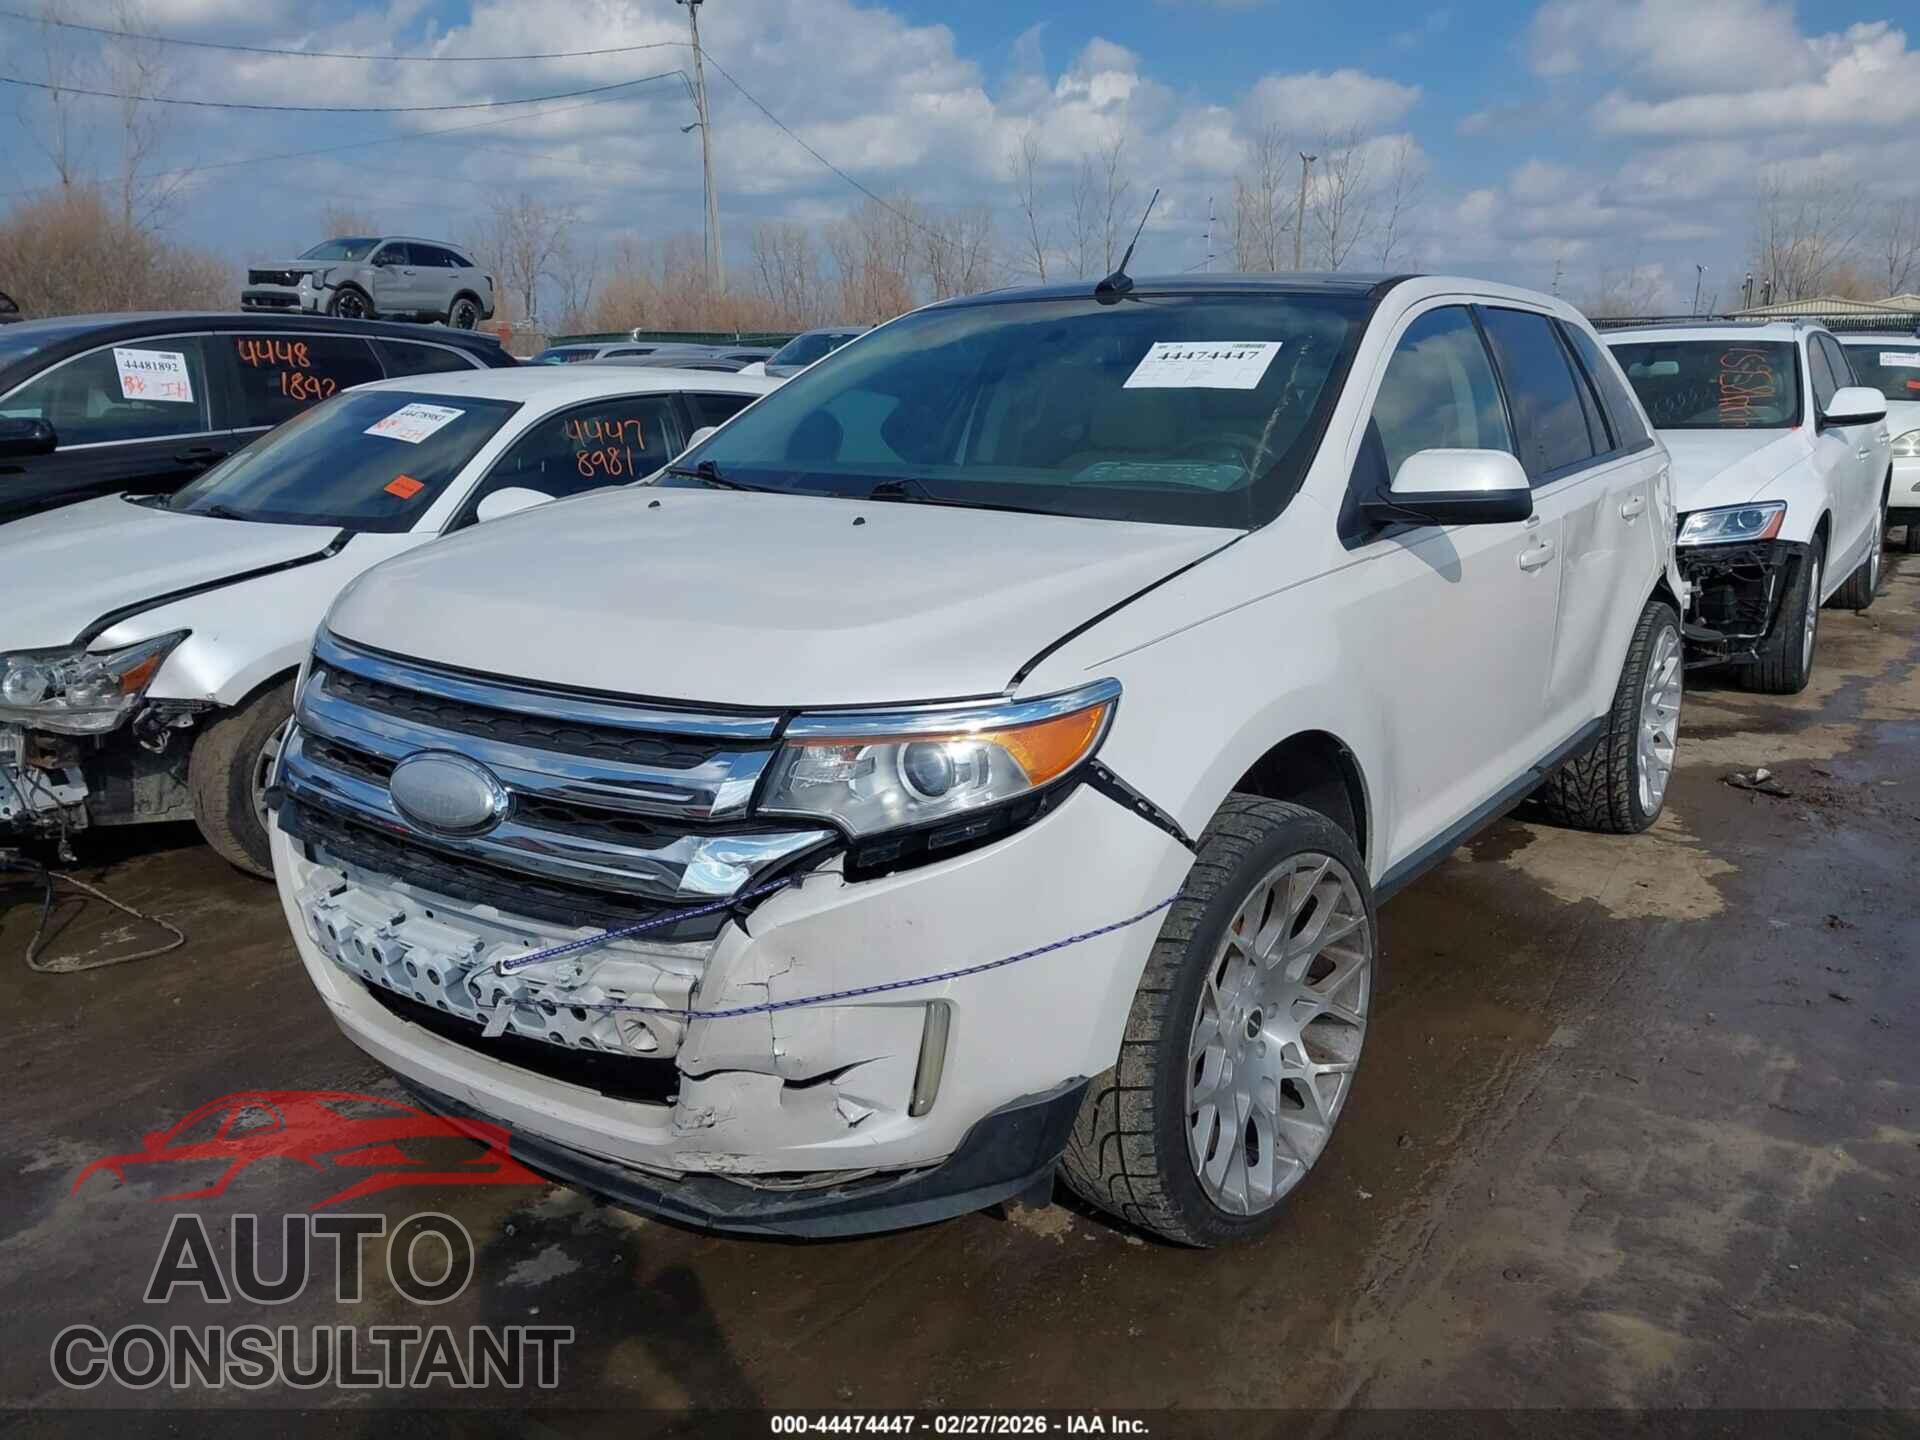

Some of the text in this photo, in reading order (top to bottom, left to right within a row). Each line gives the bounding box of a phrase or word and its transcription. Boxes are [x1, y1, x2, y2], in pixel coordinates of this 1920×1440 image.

[123, 359, 179, 372] 44481892
[239, 339, 311, 368] 4448
[1157, 351, 1259, 361] 44474447
[281, 372, 336, 400] 1892
[563, 419, 646, 450] 4447
[577, 447, 636, 477] 8981
